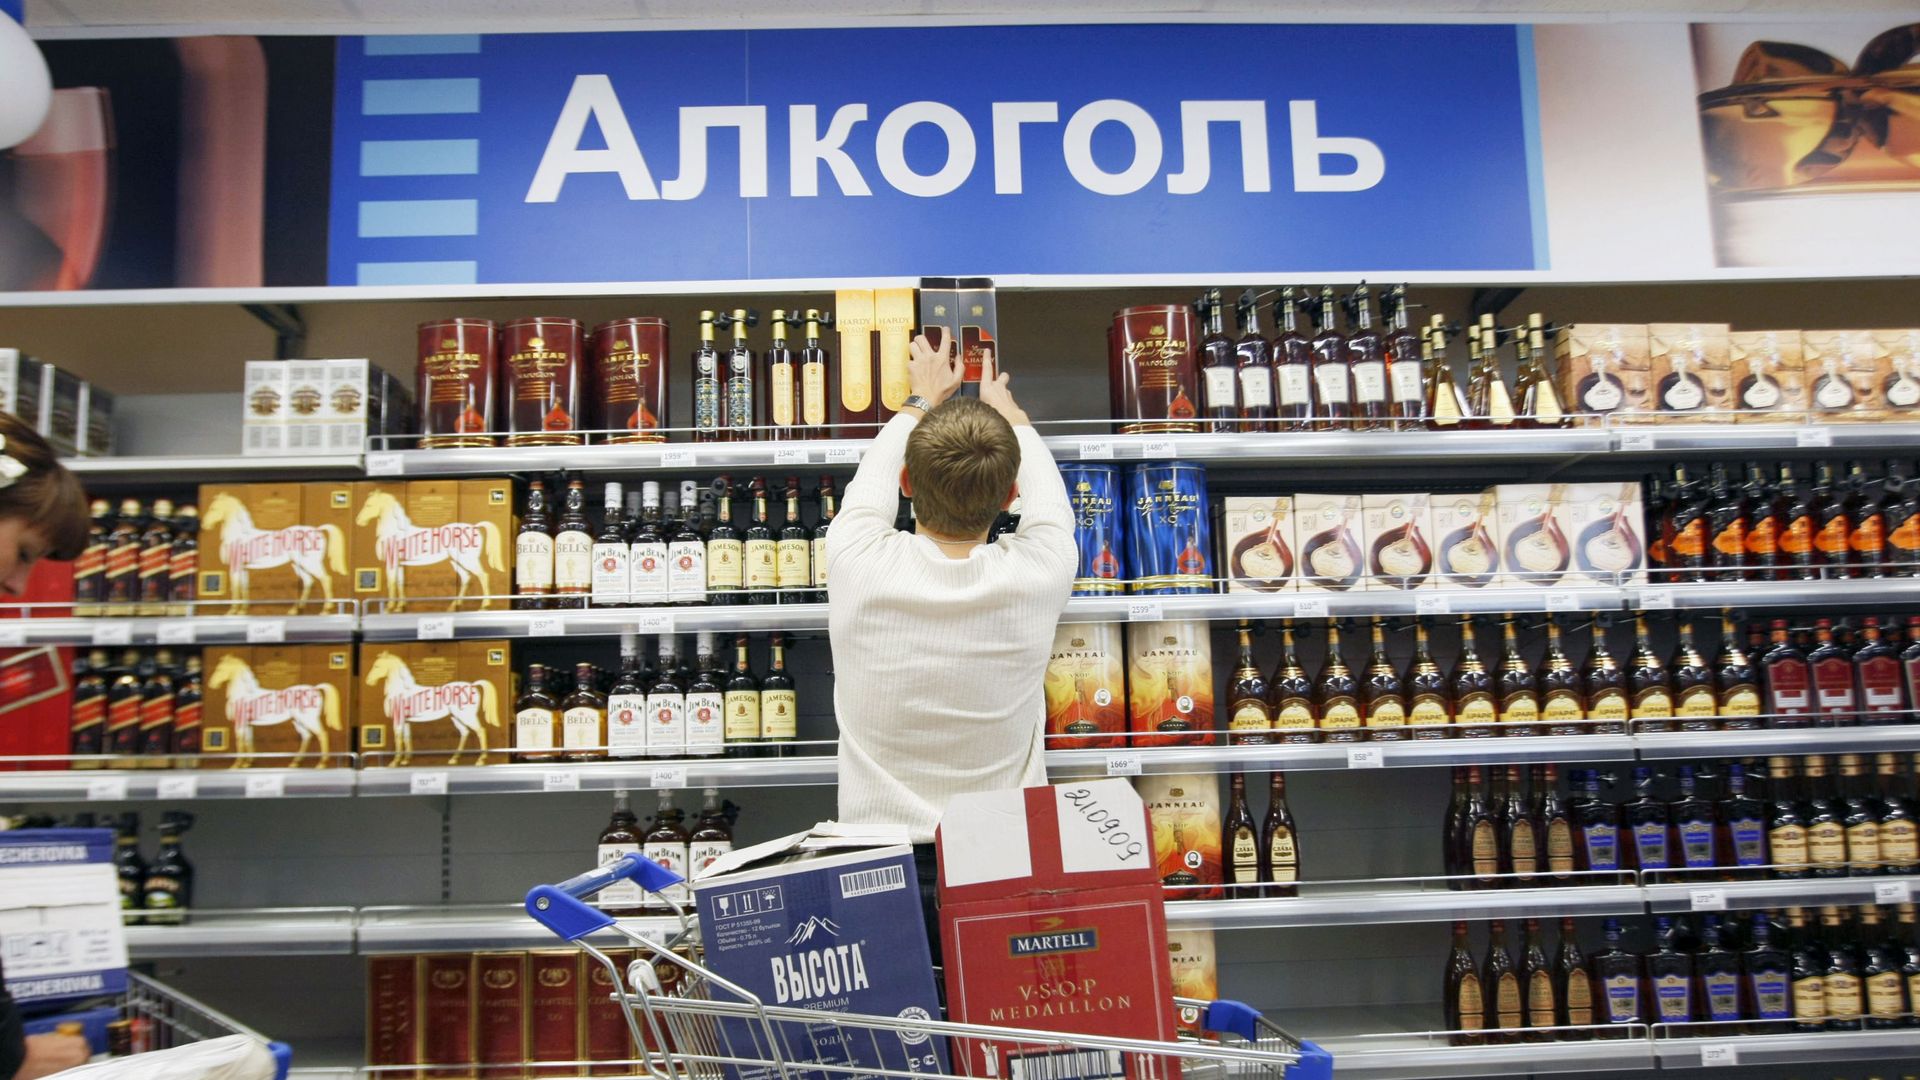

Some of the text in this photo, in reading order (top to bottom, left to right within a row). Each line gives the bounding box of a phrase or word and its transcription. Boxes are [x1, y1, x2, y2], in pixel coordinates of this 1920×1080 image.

[839, 318, 872, 326] HARDY
[878, 317, 911, 325] HARDY
[1072, 497, 1112, 505] NNEAU
[1137, 494, 1197, 505] JANNEAU
[1160, 514, 1178, 524] XO
[381, 526, 479, 570] WHITE HORSE
[516, 543, 548, 554] BELL'S
[556, 542, 588, 553] BELL'S
[710, 543, 739, 552] JAMESON
[777, 543, 804, 552] AMESON
[1050, 651, 1106, 660] JANNEAU
[1142, 649, 1198, 658] JANNEAU
[727, 694, 757, 704] JAMESON
[765, 694, 795, 703] JAMESON
[388, 684, 477, 725] WHITE HORSE
[610, 699, 643, 714] JIM BEAM
[649, 699, 682, 713] JIM BEAM
[688, 698, 721, 712] JIM BEAM
[1110, 760, 1128, 768] 1669
[1148, 801, 1205, 809] JANNEAU
[1064, 789, 1142, 861] 21.09.09
[0, 845, 88, 863] ECHEROVKA
[648, 847, 681, 861] JIM BEAM
[695, 846, 726, 862] JIM BEA
[715, 923, 730, 931] ГОСТ
[1017, 932, 1089, 952] MARTELL
[1172, 955, 1202, 963] NEAU
[770, 943, 870, 1004] ВЫСОТА
[7, 974, 105, 997] ECHEROVKA
[803, 997, 850, 1010] PREMIUM
[990, 995, 1131, 1021] MEDAILLON
